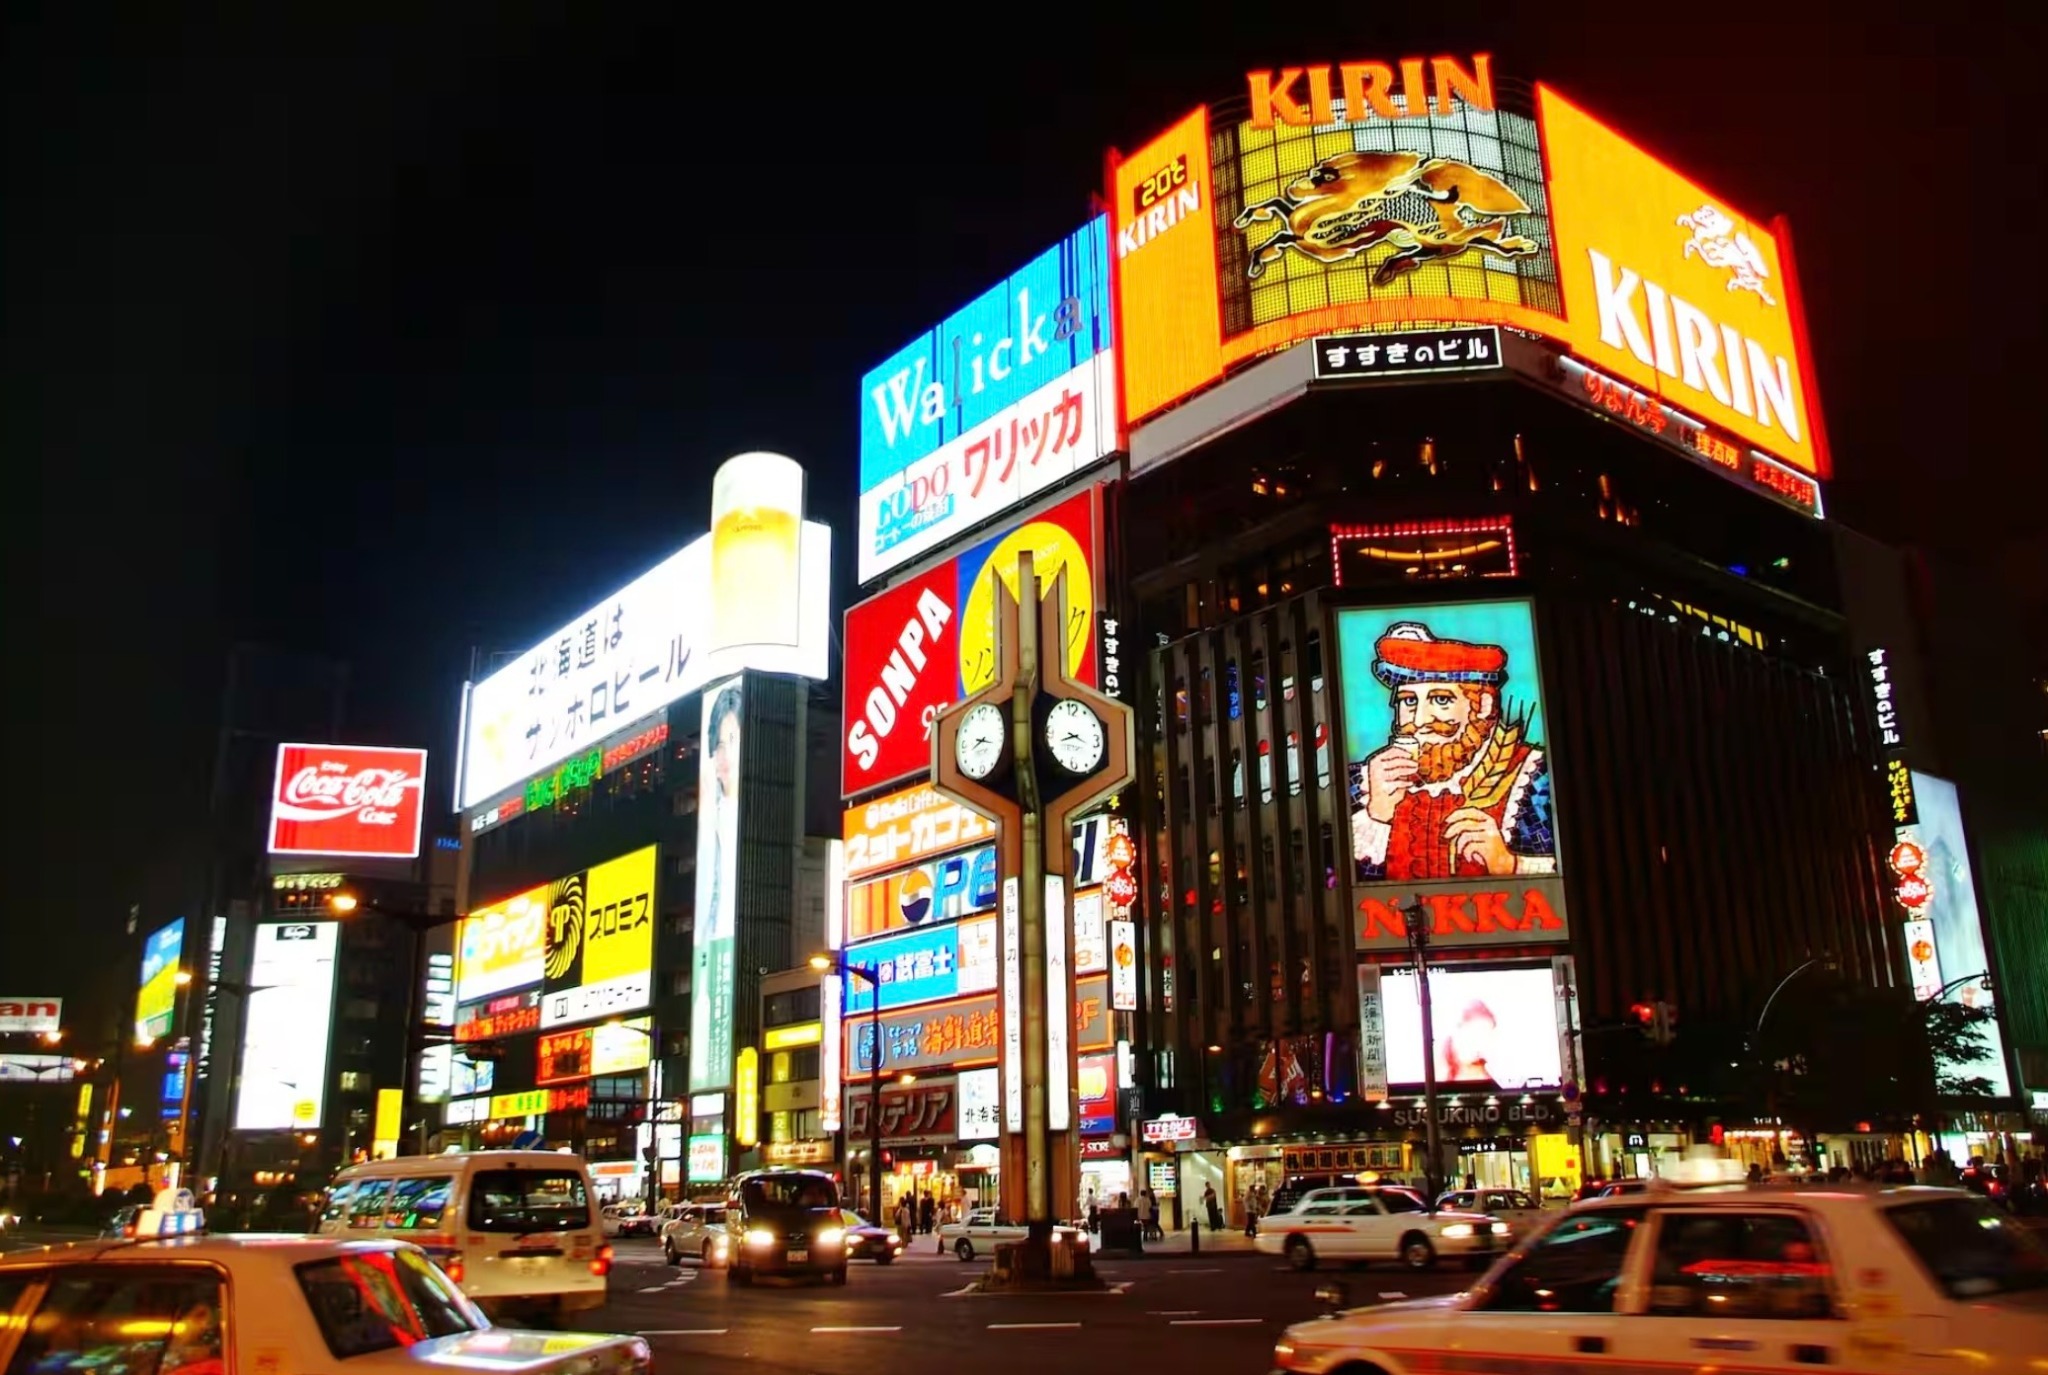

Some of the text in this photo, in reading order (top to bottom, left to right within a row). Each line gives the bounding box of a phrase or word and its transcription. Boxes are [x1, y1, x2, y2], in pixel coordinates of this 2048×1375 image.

[1247, 52, 1495, 131] KIRIN
[1118, 180, 1200, 259] KIRIN
[871, 287, 1084, 448] Walicka
[1325, 339, 1489, 369] すすきのビル
[1587, 247, 1800, 445] KIRIN
[964, 389, 1083, 499] ワリッカ
[848, 587, 952, 771] SONPA
[1868, 648, 1900, 745] すすきのビル
[286, 766, 408, 807] Coca-Cola
[844, 805, 996, 872] ネットカフェ
[589, 892, 649, 941] プロミス
[1360, 888, 1564, 940] NKKA
